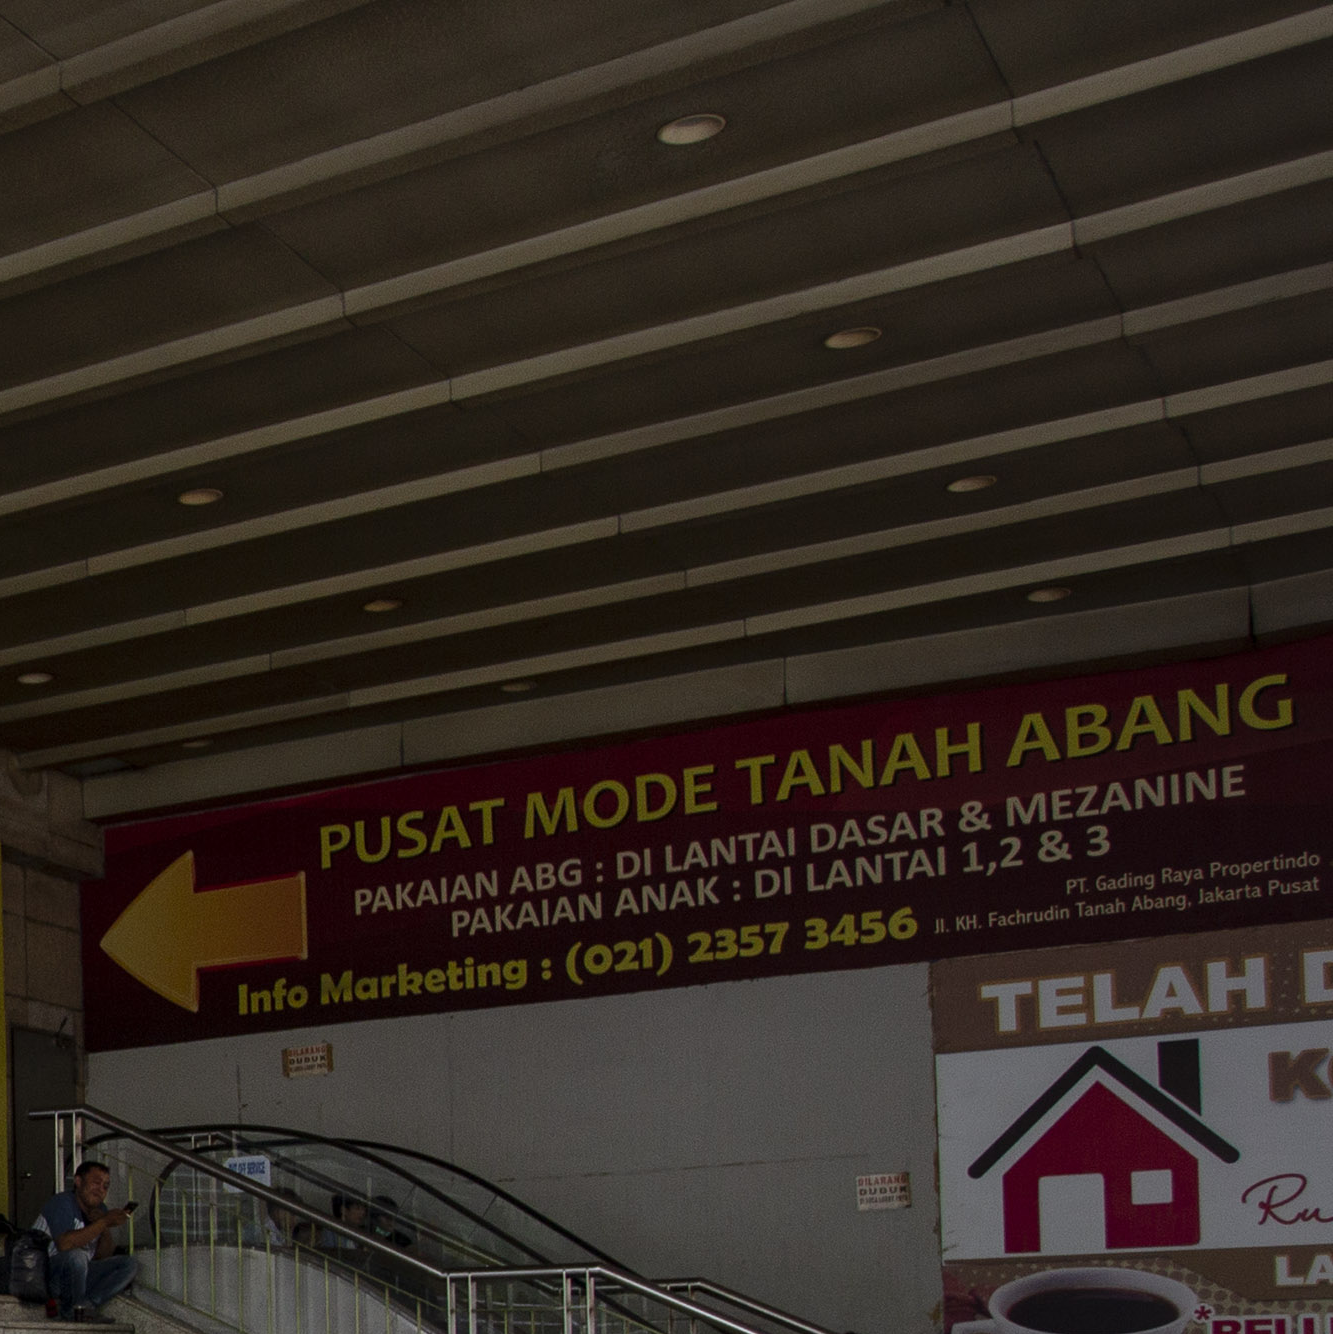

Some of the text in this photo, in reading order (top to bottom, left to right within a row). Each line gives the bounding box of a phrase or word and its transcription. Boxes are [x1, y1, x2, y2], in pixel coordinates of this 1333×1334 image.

[319, 673, 1297, 870] PUSAT MODE TANAH ABANG
[354, 764, 1247, 916] PAKAIAN ABG : DI LANTAI DASAR & MEZANINE
[450, 824, 1112, 938] PAKAIAN ANAK : DI LANTAI 1,2 & 3
[1066, 851, 1321, 896] PT. Gading Raya Propertindo
[955, 914, 983, 931] KH.
[988, 900, 1070, 928] Fachrudin
[1076, 899, 1126, 918] Tanah
[1132, 892, 1193, 913] Abang,
[1198, 884, 1262, 906] Jakarta
[1268, 876, 1321, 897] Pusat
[237, 906, 919, 1016] Info Marketing : (021) 2357 3456
[980, 957, 1268, 1032] TELAH
